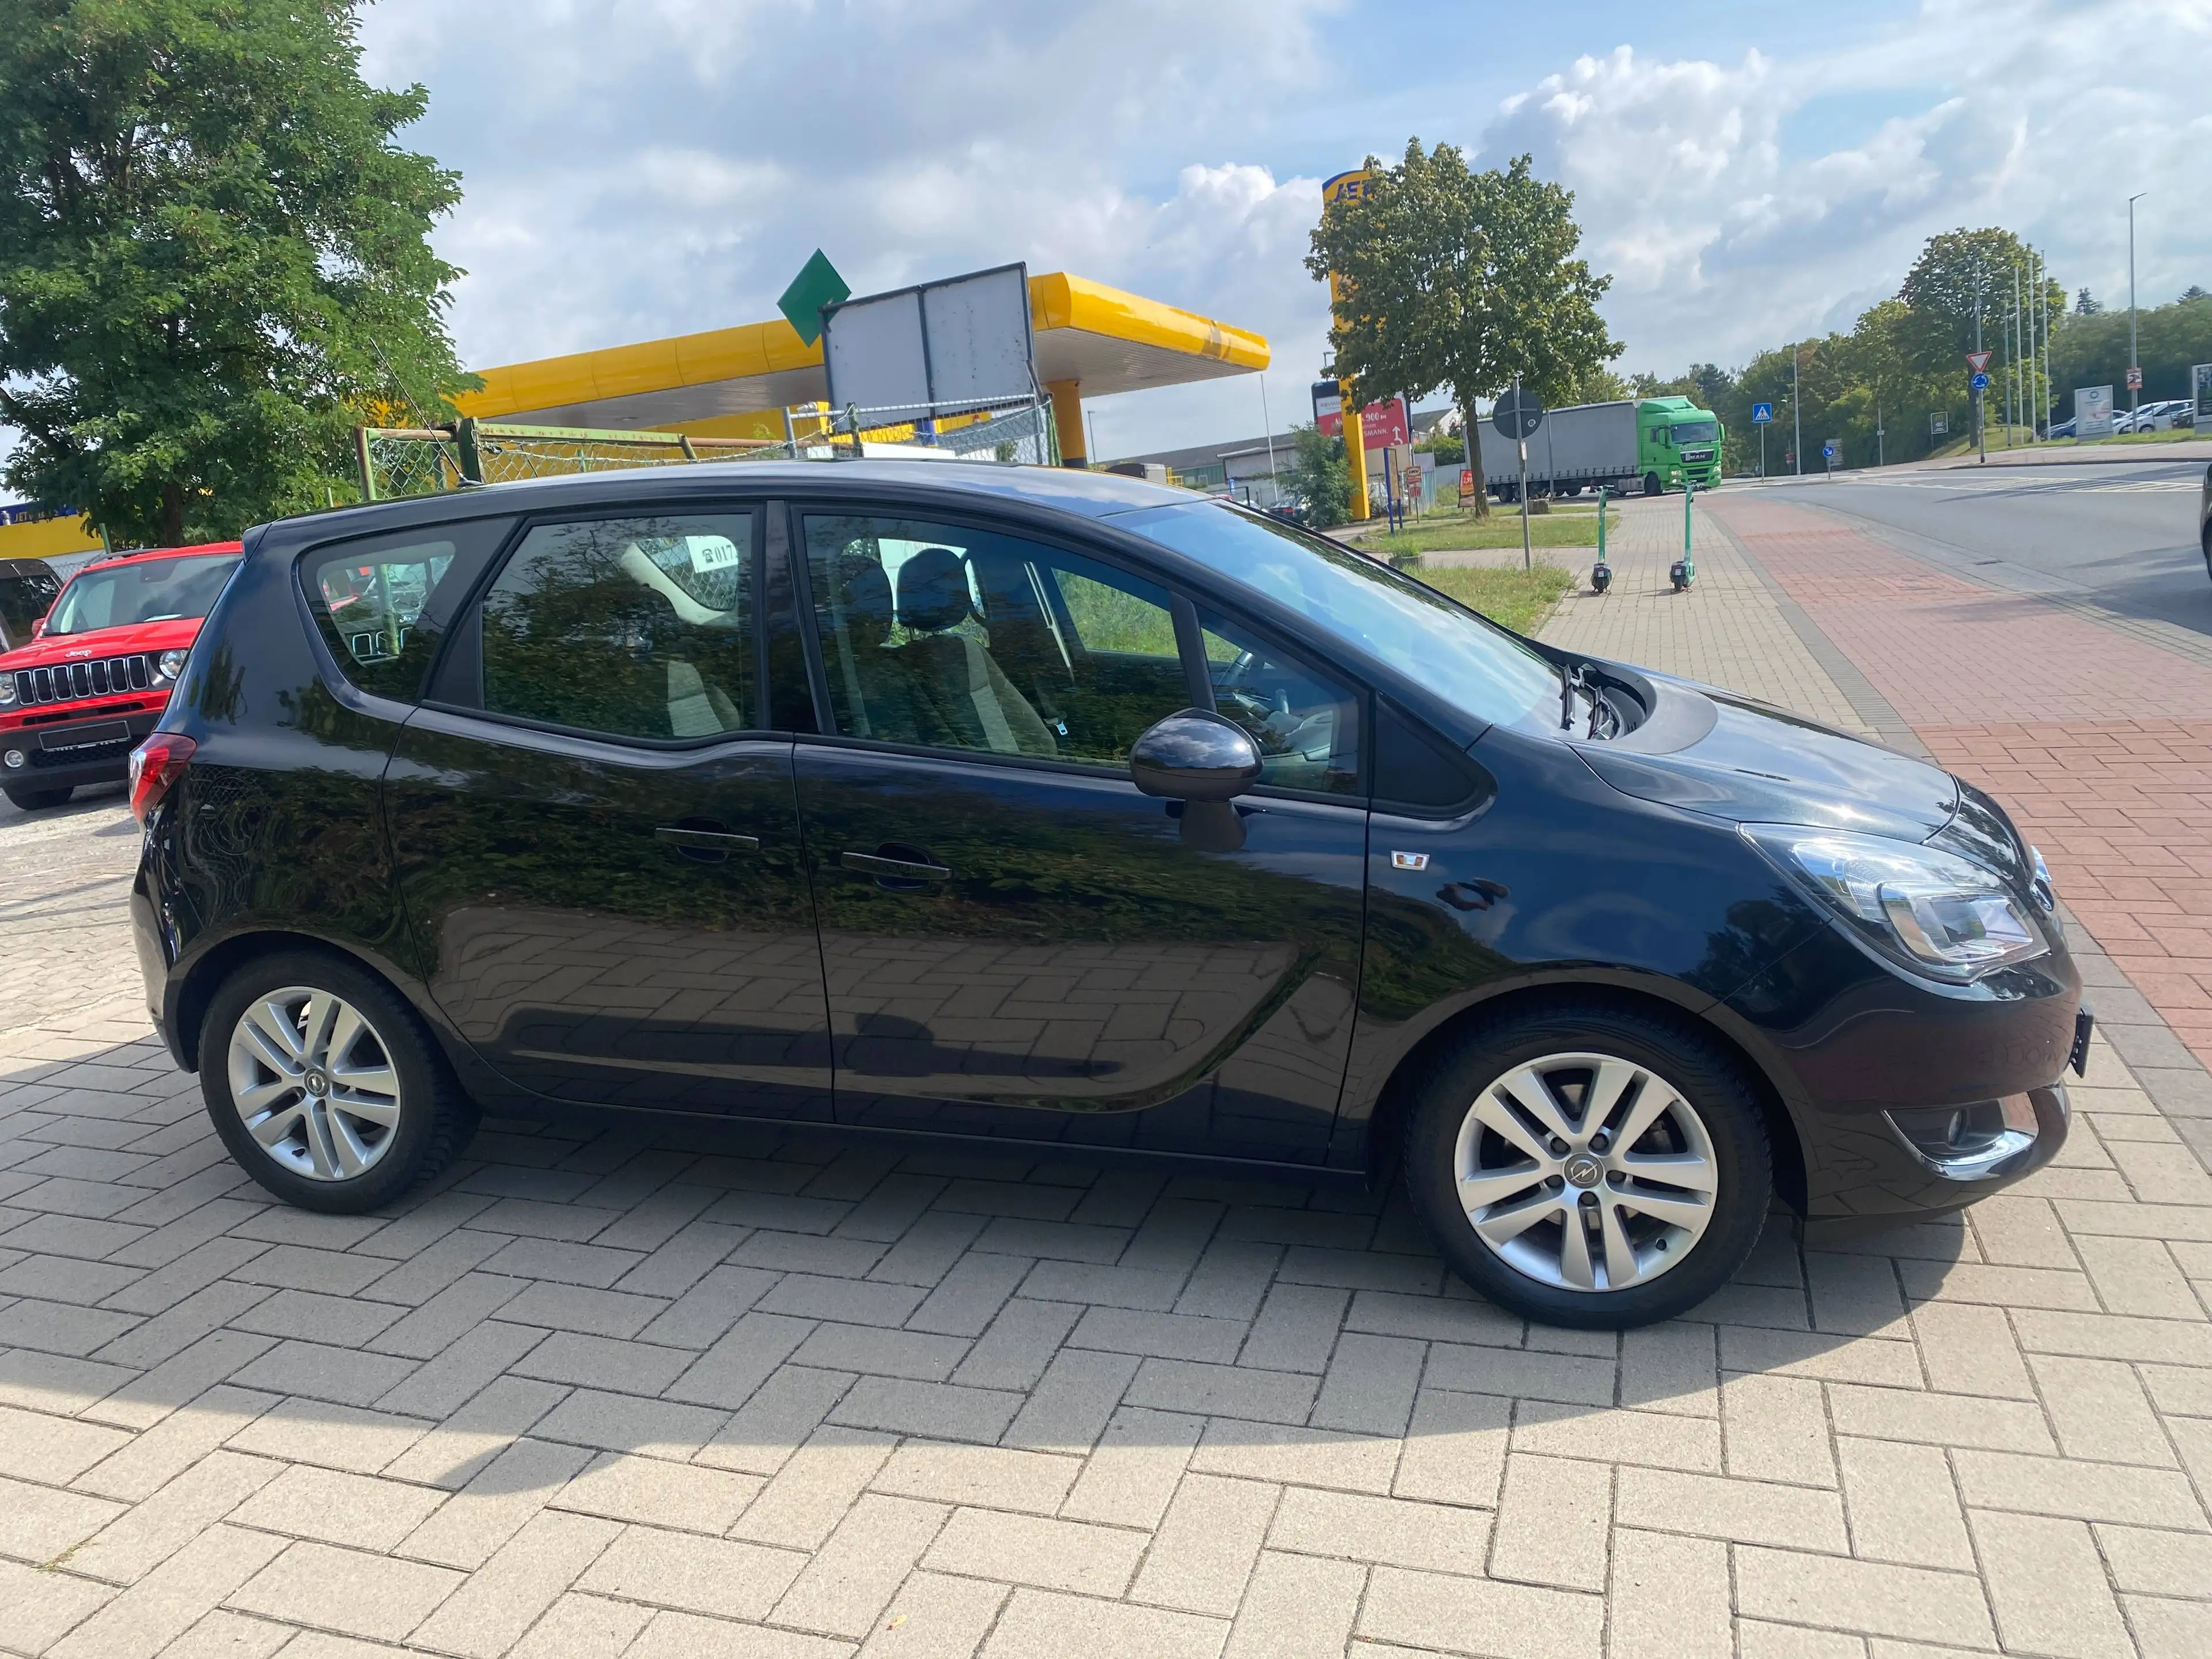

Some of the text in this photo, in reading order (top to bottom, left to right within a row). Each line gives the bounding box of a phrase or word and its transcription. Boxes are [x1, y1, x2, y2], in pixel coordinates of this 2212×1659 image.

[1366, 412, 1380, 422] 900
[14, 510, 28, 522] JET
[714, 544, 738, 563] 017
[65, 649, 92, 658] Jeep
